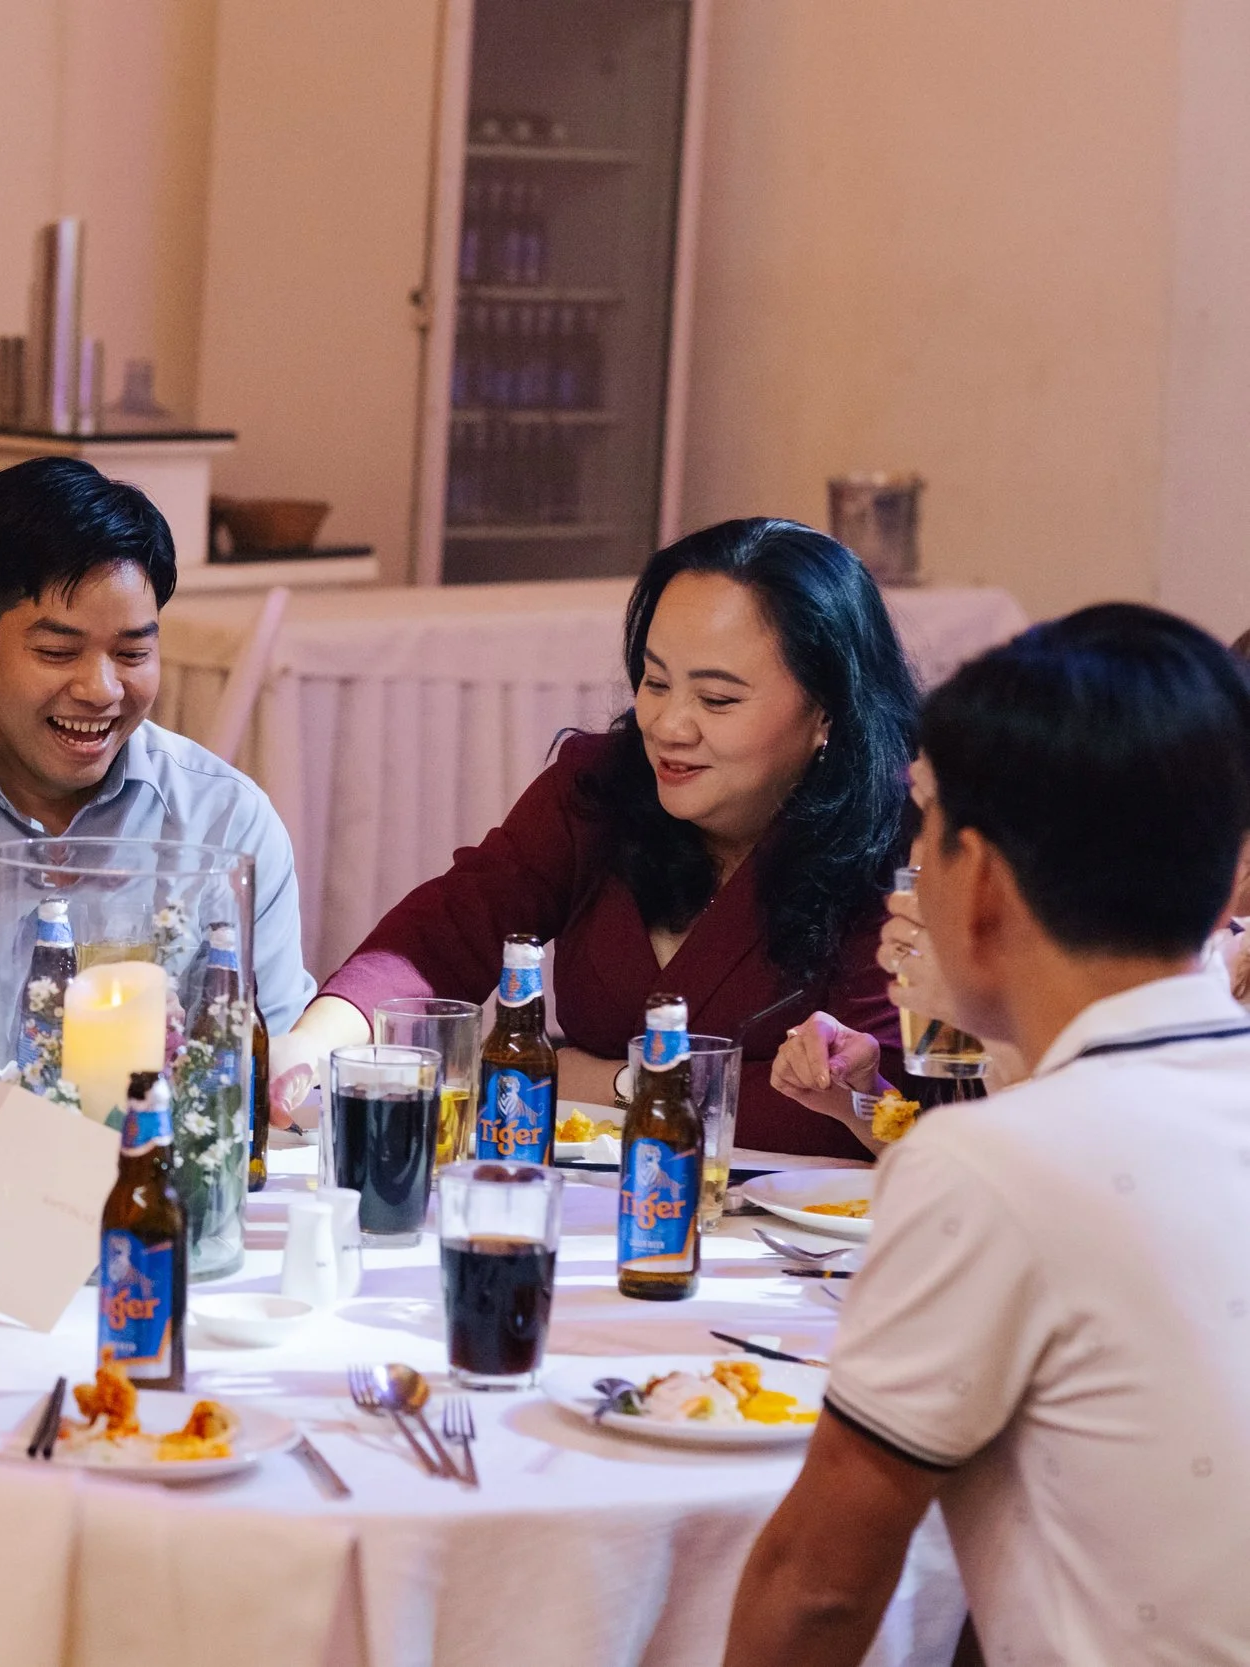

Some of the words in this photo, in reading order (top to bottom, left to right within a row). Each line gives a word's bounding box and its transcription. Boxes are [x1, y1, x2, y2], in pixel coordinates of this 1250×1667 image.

[480, 1119, 543, 1156] Tiger
[621, 1189, 686, 1230] Tiger
[100, 1287, 160, 1331] iger
